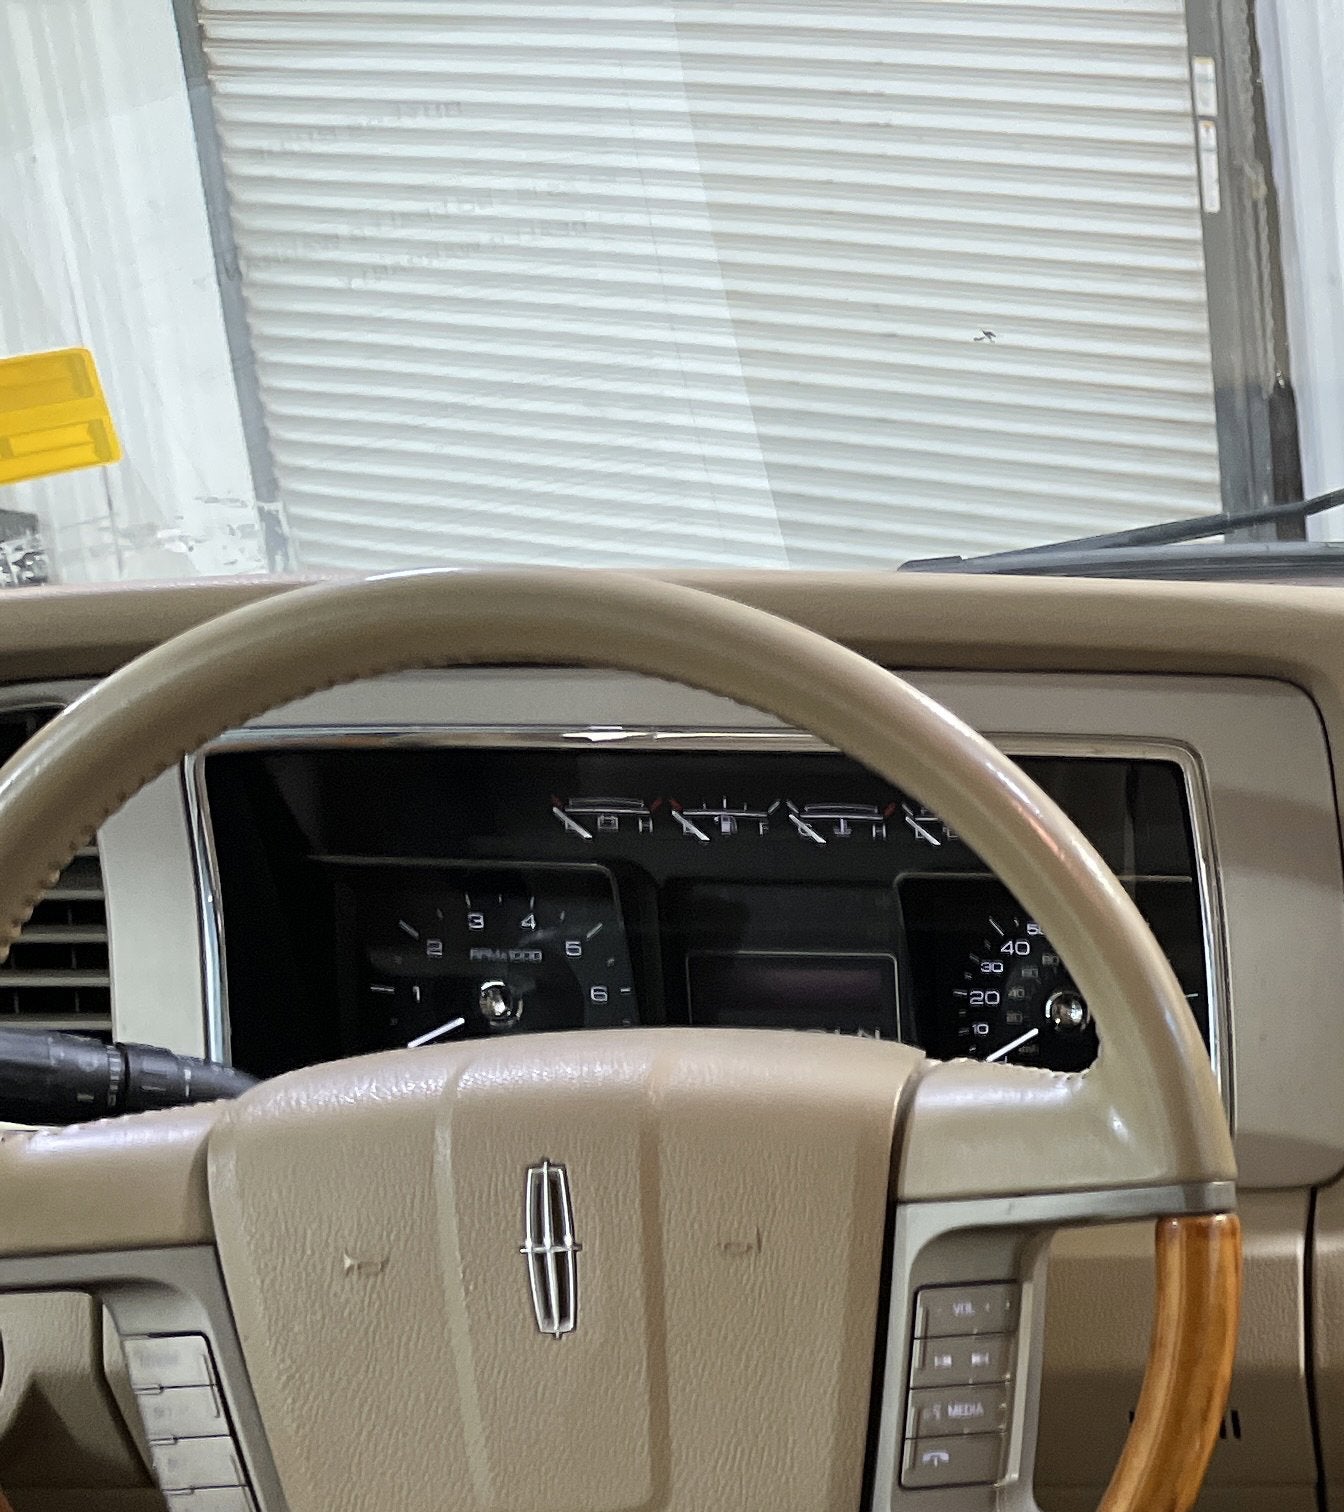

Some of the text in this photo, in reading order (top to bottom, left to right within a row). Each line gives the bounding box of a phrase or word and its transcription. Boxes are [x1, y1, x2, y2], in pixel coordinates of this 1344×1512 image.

[520, 913, 536, 930] 4
[565, 941, 582, 957] 5
[1000, 941, 1030, 956] 40
[981, 962, 1003, 973] 30
[591, 986, 608, 1002] 6
[970, 990, 1000, 1005] 20
[972, 1024, 989, 1035] 10
